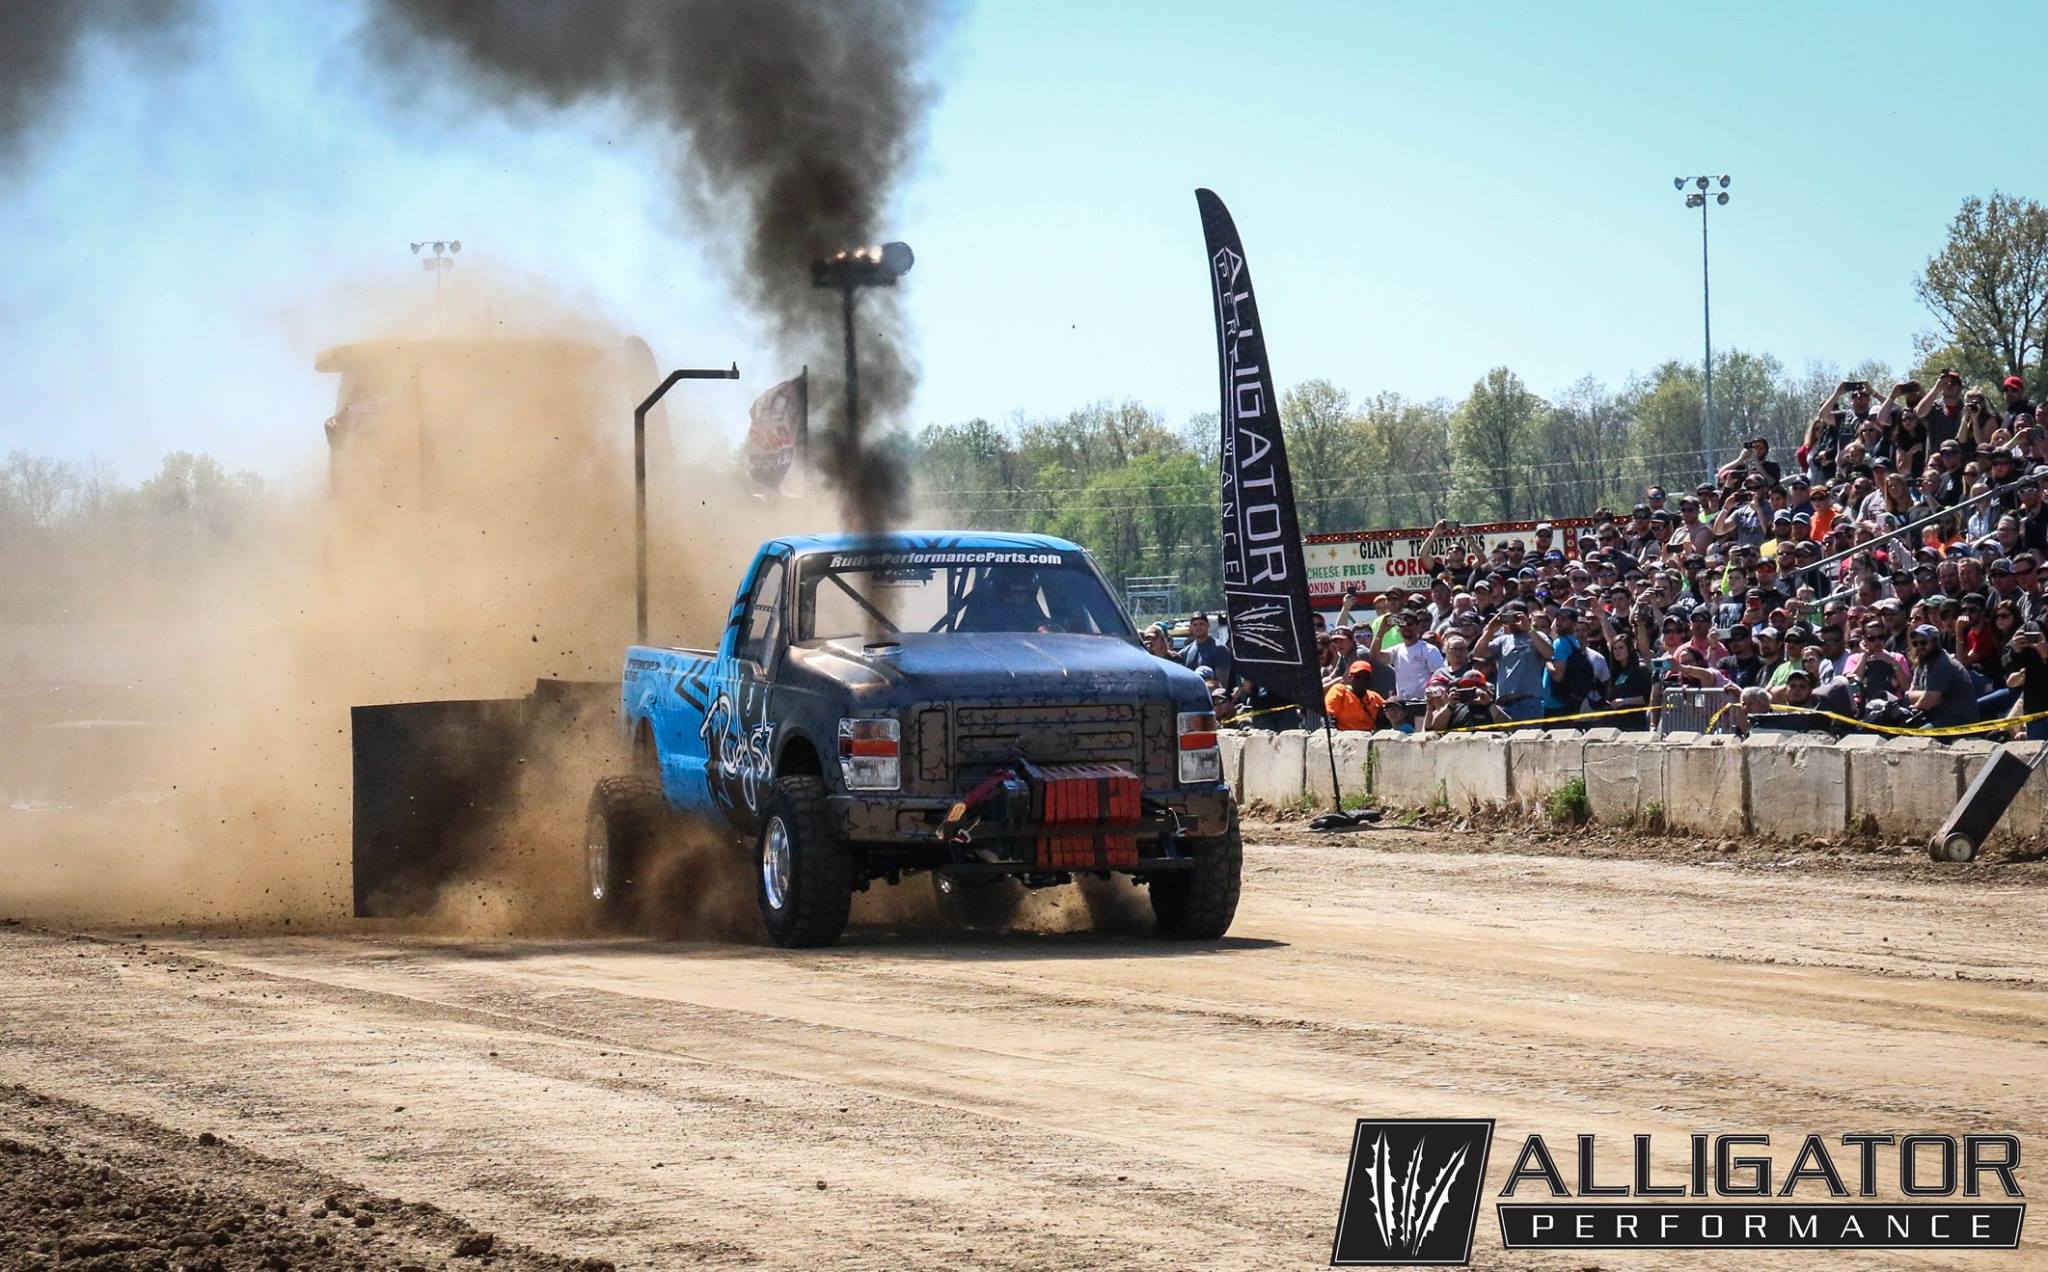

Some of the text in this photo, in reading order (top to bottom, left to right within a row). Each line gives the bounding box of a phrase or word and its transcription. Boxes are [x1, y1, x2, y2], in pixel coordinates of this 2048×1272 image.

[1218, 262, 1240, 574] PERMANCE
[1225, 247, 1287, 584] ALLIGATOR
[1360, 540, 1394, 560] GIANT
[829, 552, 1062, 568] RudysPerformanceParts.com
[1385, 558, 1430, 577] CORN
[1306, 563, 1376, 579] CHEESE FRIES
[1308, 580, 1367, 594] ONION RINGS
